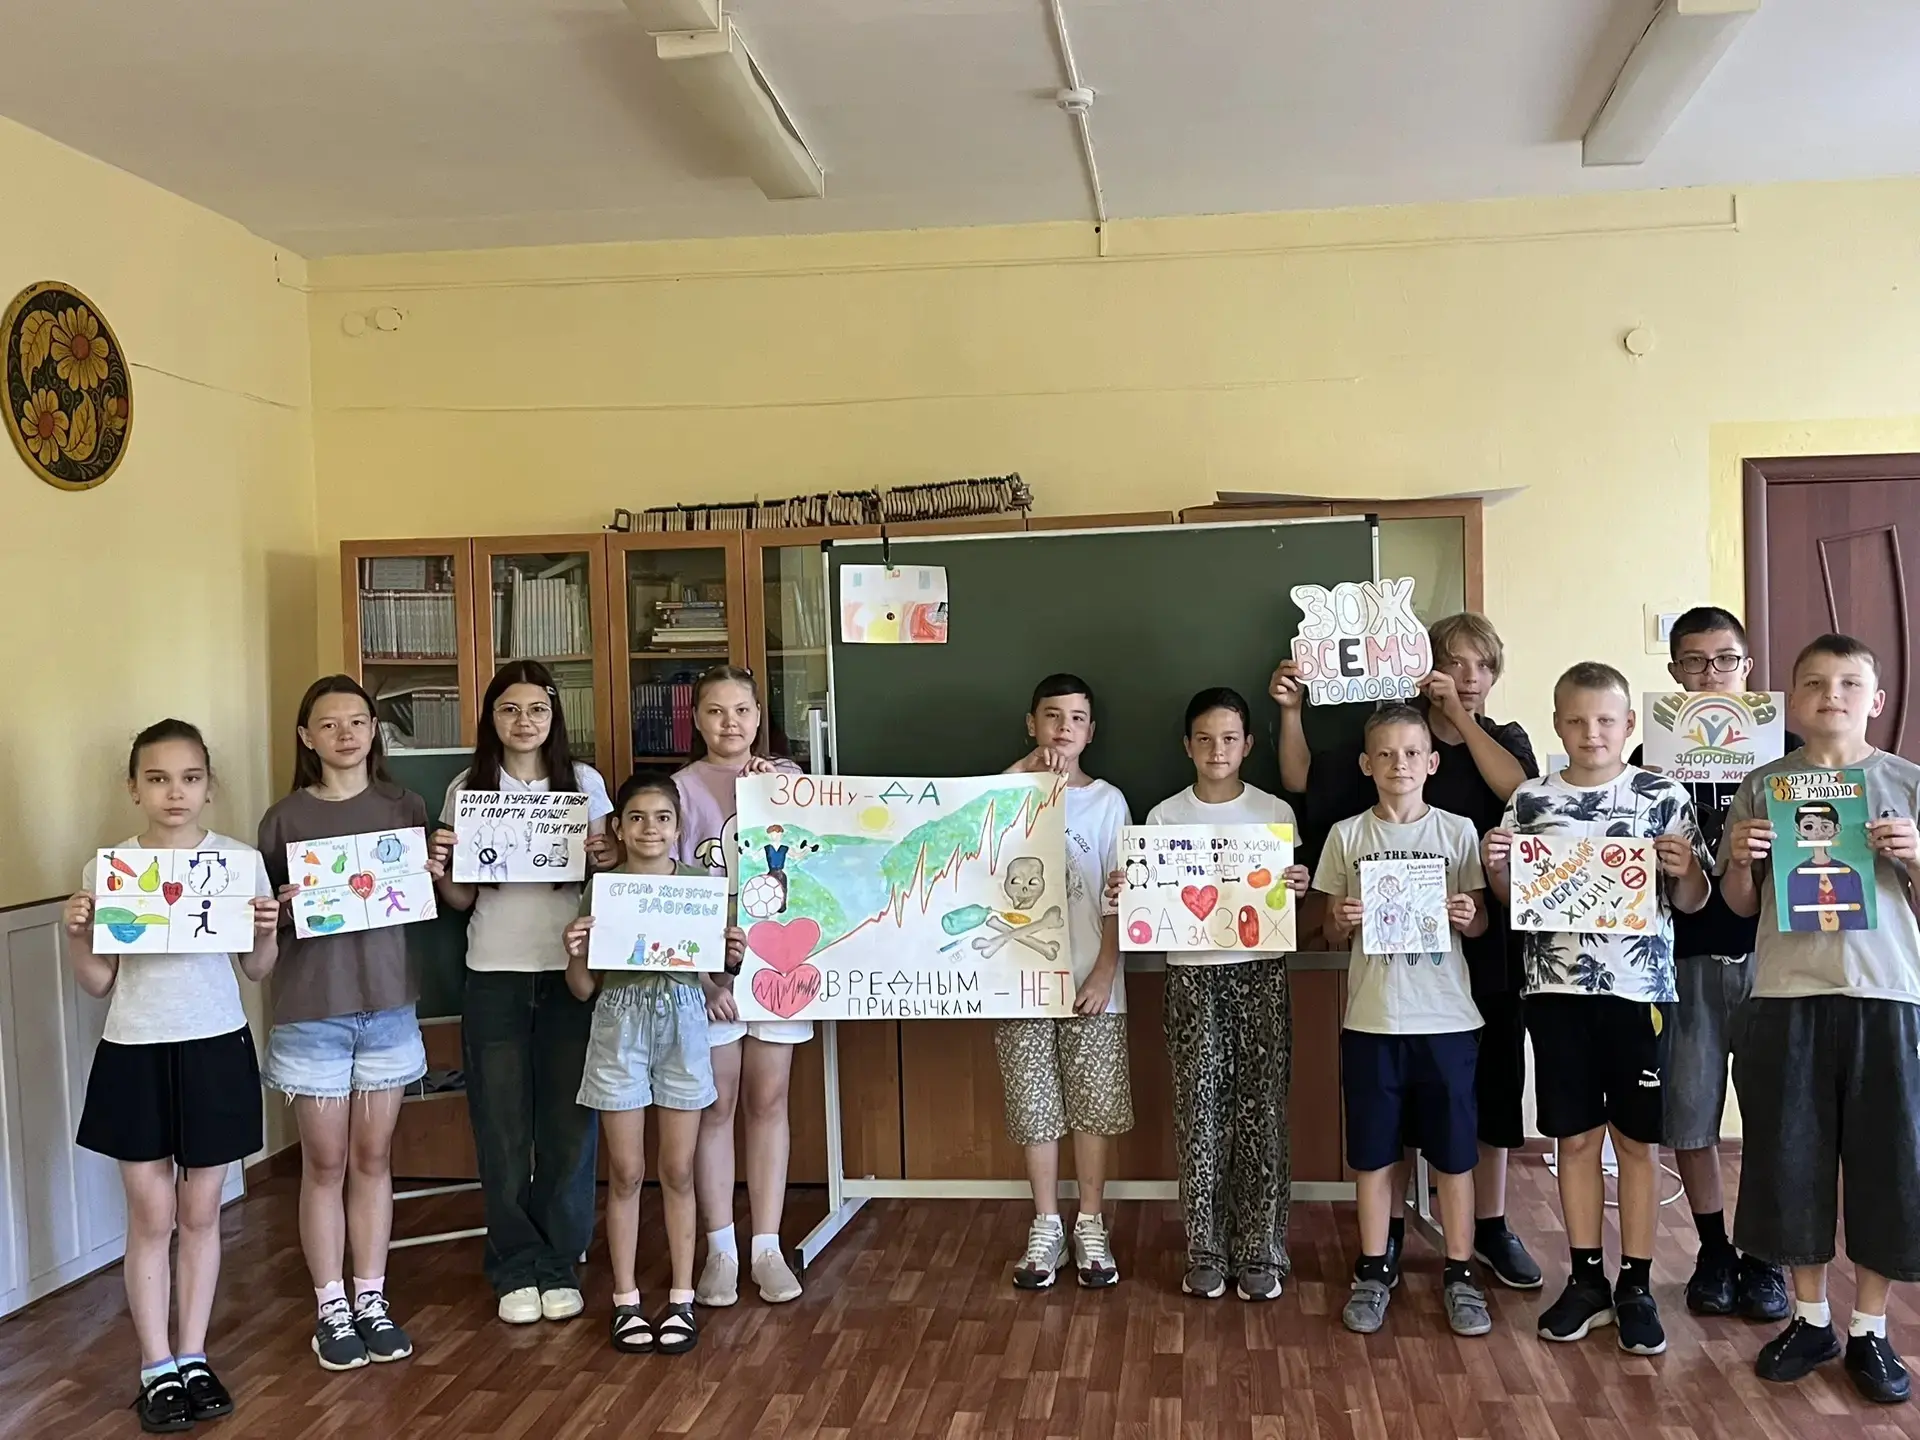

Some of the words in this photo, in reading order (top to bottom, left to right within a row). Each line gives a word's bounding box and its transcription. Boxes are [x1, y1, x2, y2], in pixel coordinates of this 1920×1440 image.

[1295, 579, 1418, 641] ЗОЖ
[1294, 631, 1428, 681] ВСЕМУ
[1310, 676, 1417, 704] ГОЛОВА
[1674, 751, 1756, 767] здоровый
[1665, 767, 1711, 781] образ
[1775, 772, 1838, 787] КУРИТЬ
[460, 792, 501, 805] ДОЛОЙ
[503, 794, 551, 805] КУРЕНИЕ
[552, 795, 562, 805] И
[878, 780, 941, 806] ДА
[1781, 787, 1802, 800] НЕ
[1807, 785, 1852, 799] МОДНО
[460, 807, 476, 818] ОТ
[481, 807, 526, 819] СПОРТА
[530, 808, 570, 819] БОЛЬШЕ
[1072, 833, 1091, 854] 2025
[1153, 837, 1206, 851] ЗДОРОВЫЙ
[1211, 837, 1238, 851] ОБРАЗ
[1243, 839, 1281, 852] ЖИЗНИ
[1519, 836, 1553, 864] 9А
[1229, 853, 1245, 863] 100
[1384, 850, 1408, 860] THE
[1519, 838, 1594, 902] ЗДОРОВЫЙ
[609, 882, 654, 897] СТИЛЬ
[658, 884, 713, 899] ЖИЗНИ
[1542, 868, 1591, 910] ОБРАЗ
[1560, 874, 1616, 925] ЖИЗНИ
[1127, 906, 1178, 945] 6А
[1187, 925, 1211, 947] ЗА
[1213, 904, 1293, 949] ЗОЖ
[820, 969, 980, 1002] ВРЕДНЫМ
[1020, 969, 1071, 1009] НЕТ
[847, 997, 983, 1017] ПРИВЫЧКАМ
